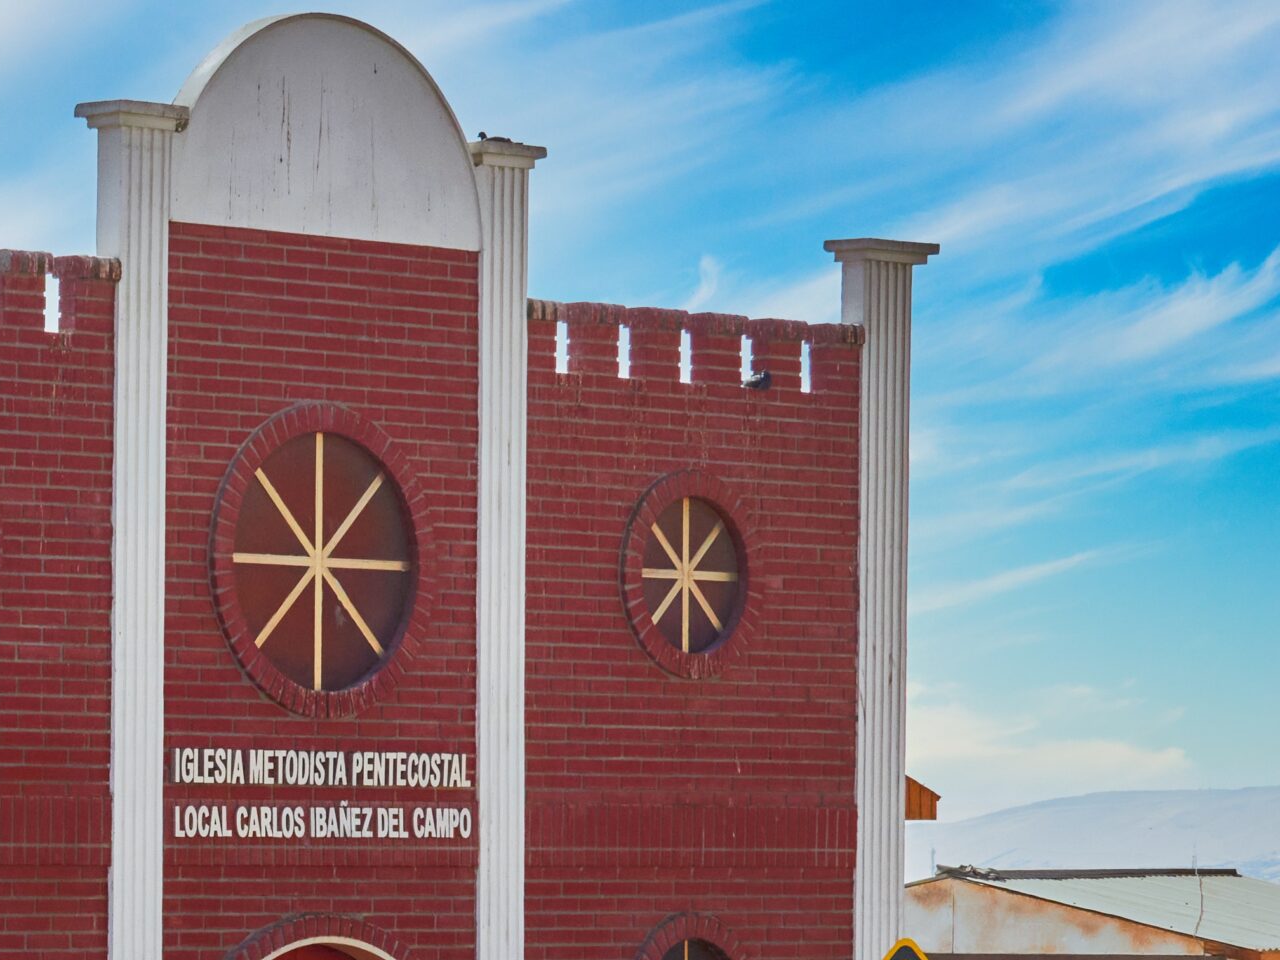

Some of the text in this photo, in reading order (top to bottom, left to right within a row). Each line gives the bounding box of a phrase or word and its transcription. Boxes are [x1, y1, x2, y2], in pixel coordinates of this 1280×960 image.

[174, 747, 471, 788] IGLESIA METODISTA PENTECOSTAL
[174, 800, 471, 838] LOCAL CARLOS IBAÑEZ DEL CAMPO
